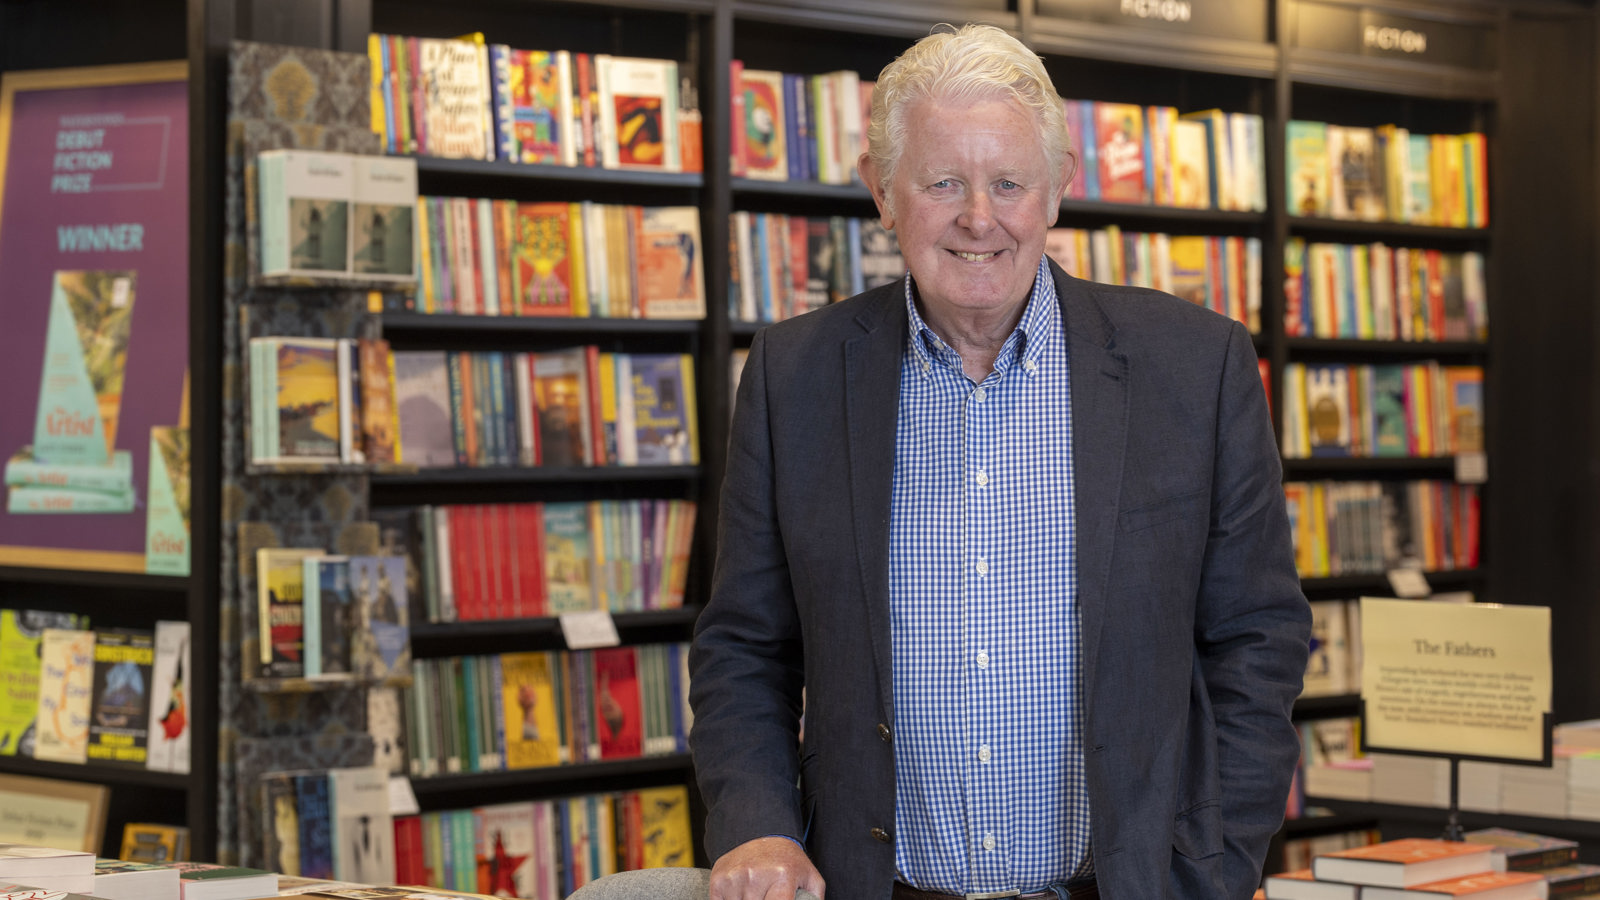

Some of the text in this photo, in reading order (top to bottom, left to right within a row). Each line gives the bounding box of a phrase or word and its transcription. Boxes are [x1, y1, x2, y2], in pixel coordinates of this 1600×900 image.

[1364, 25, 1426, 52] FICTION
[56, 129, 106, 149] DEBUT
[54, 152, 112, 171] FICTION
[52, 174, 93, 192] PRIZE
[57, 224, 144, 252] WINNER
[1412, 639, 1496, 658] The Fathers
